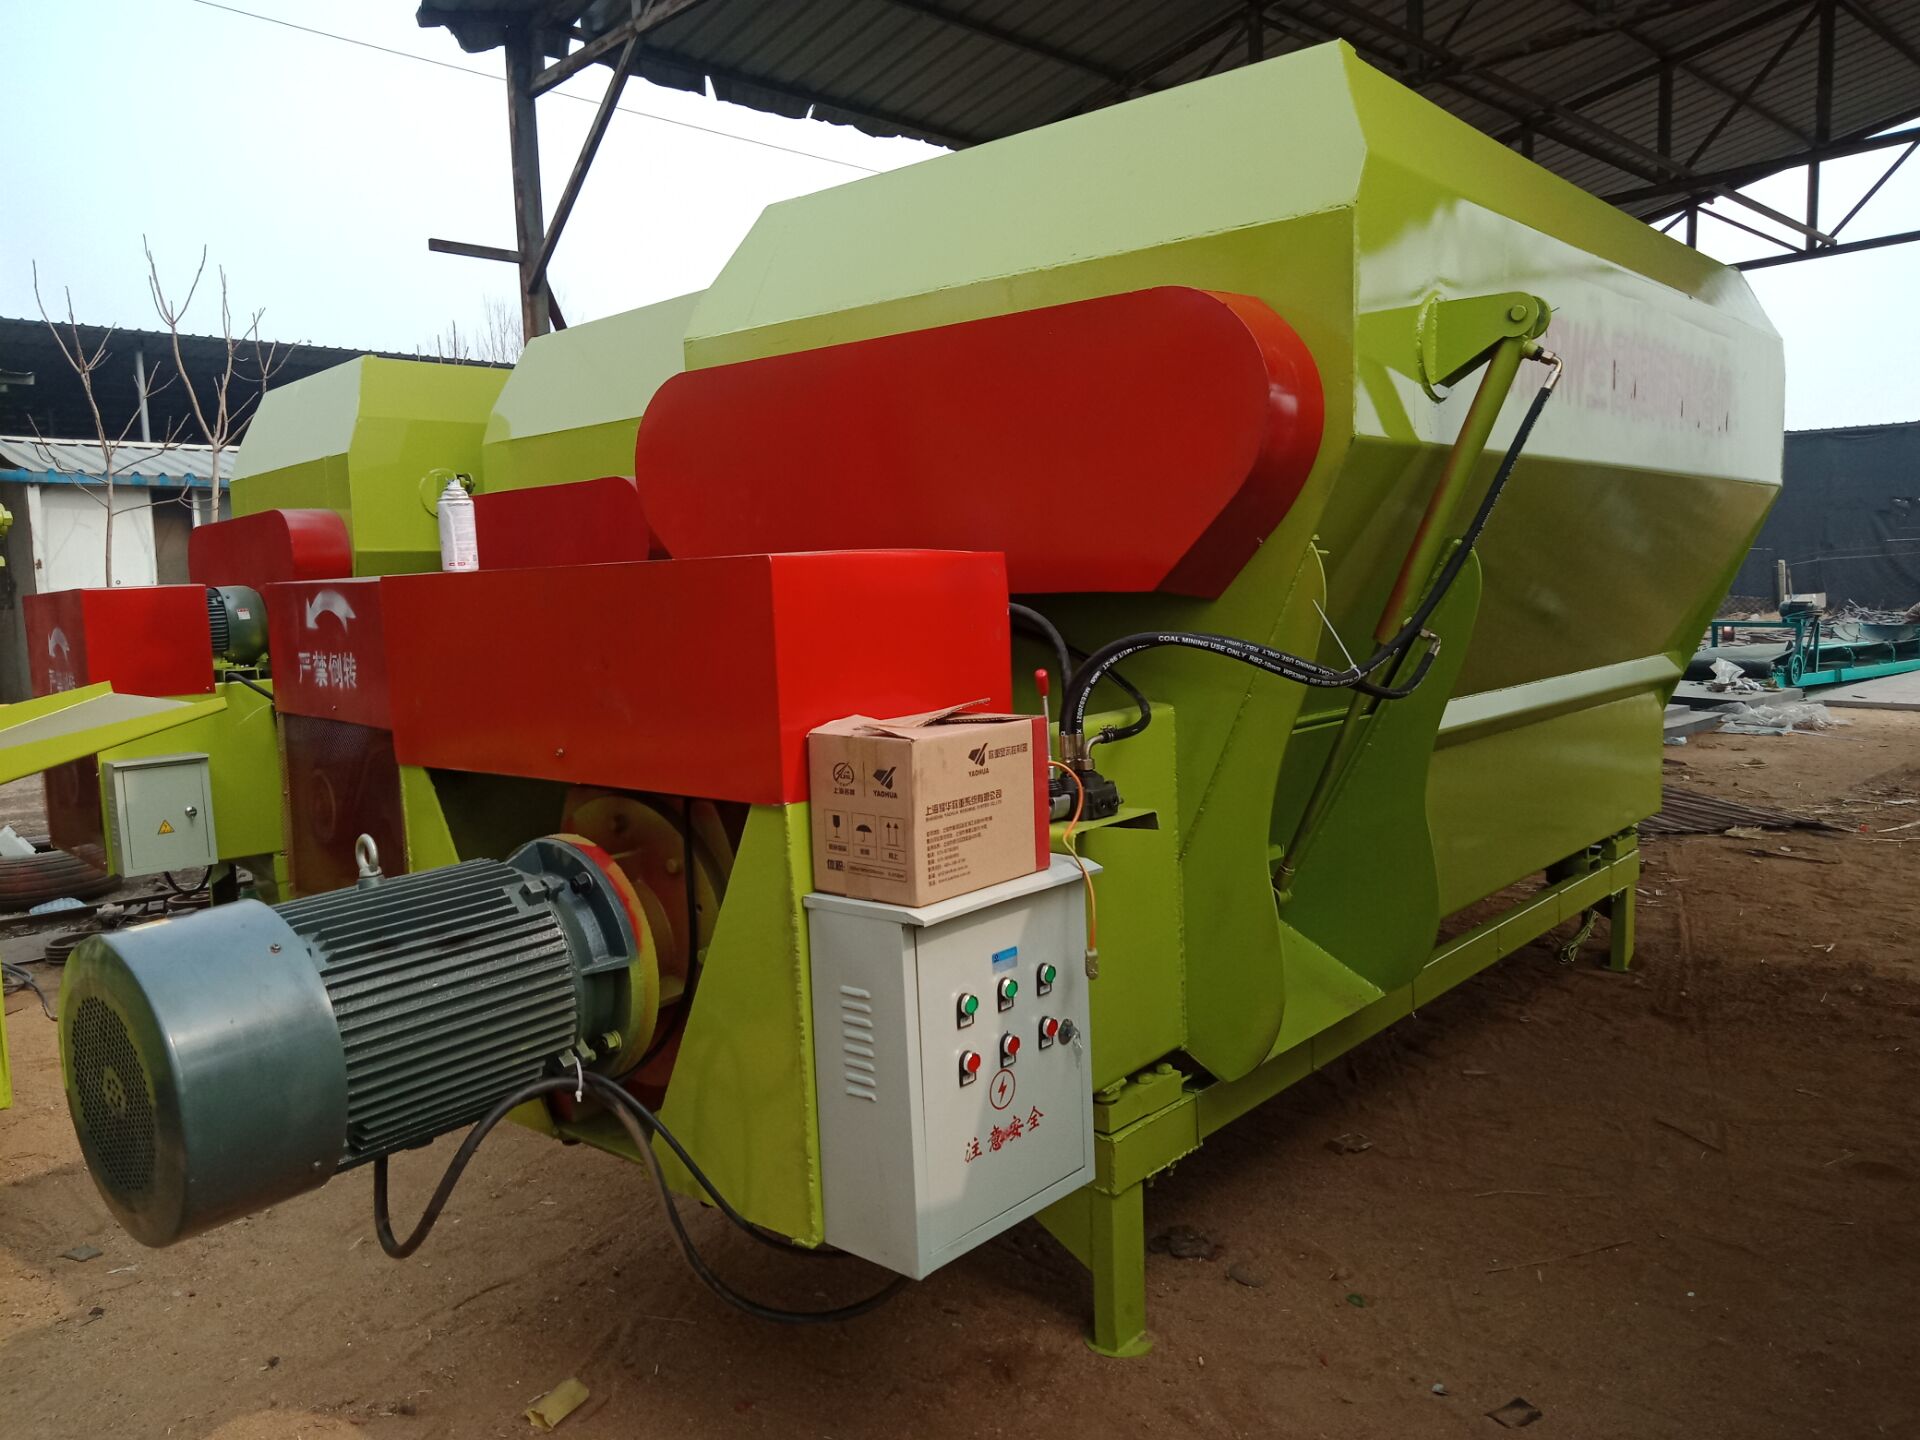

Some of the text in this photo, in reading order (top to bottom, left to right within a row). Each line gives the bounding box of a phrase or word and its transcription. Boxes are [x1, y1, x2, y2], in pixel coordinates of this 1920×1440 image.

[1158, 635, 1180, 643] COAL
[1182, 637, 1209, 647] MINING
[1210, 642, 1226, 652] USE
[1226, 647, 1247, 658] ONLY
[1262, 649, 1281, 659] ONLY
[1281, 655, 1295, 664] USE
[1295, 660, 1317, 672] MINING
[873, 790, 898, 799] YAOHUA
[965, 1105, 1044, 1163] 注意安全
